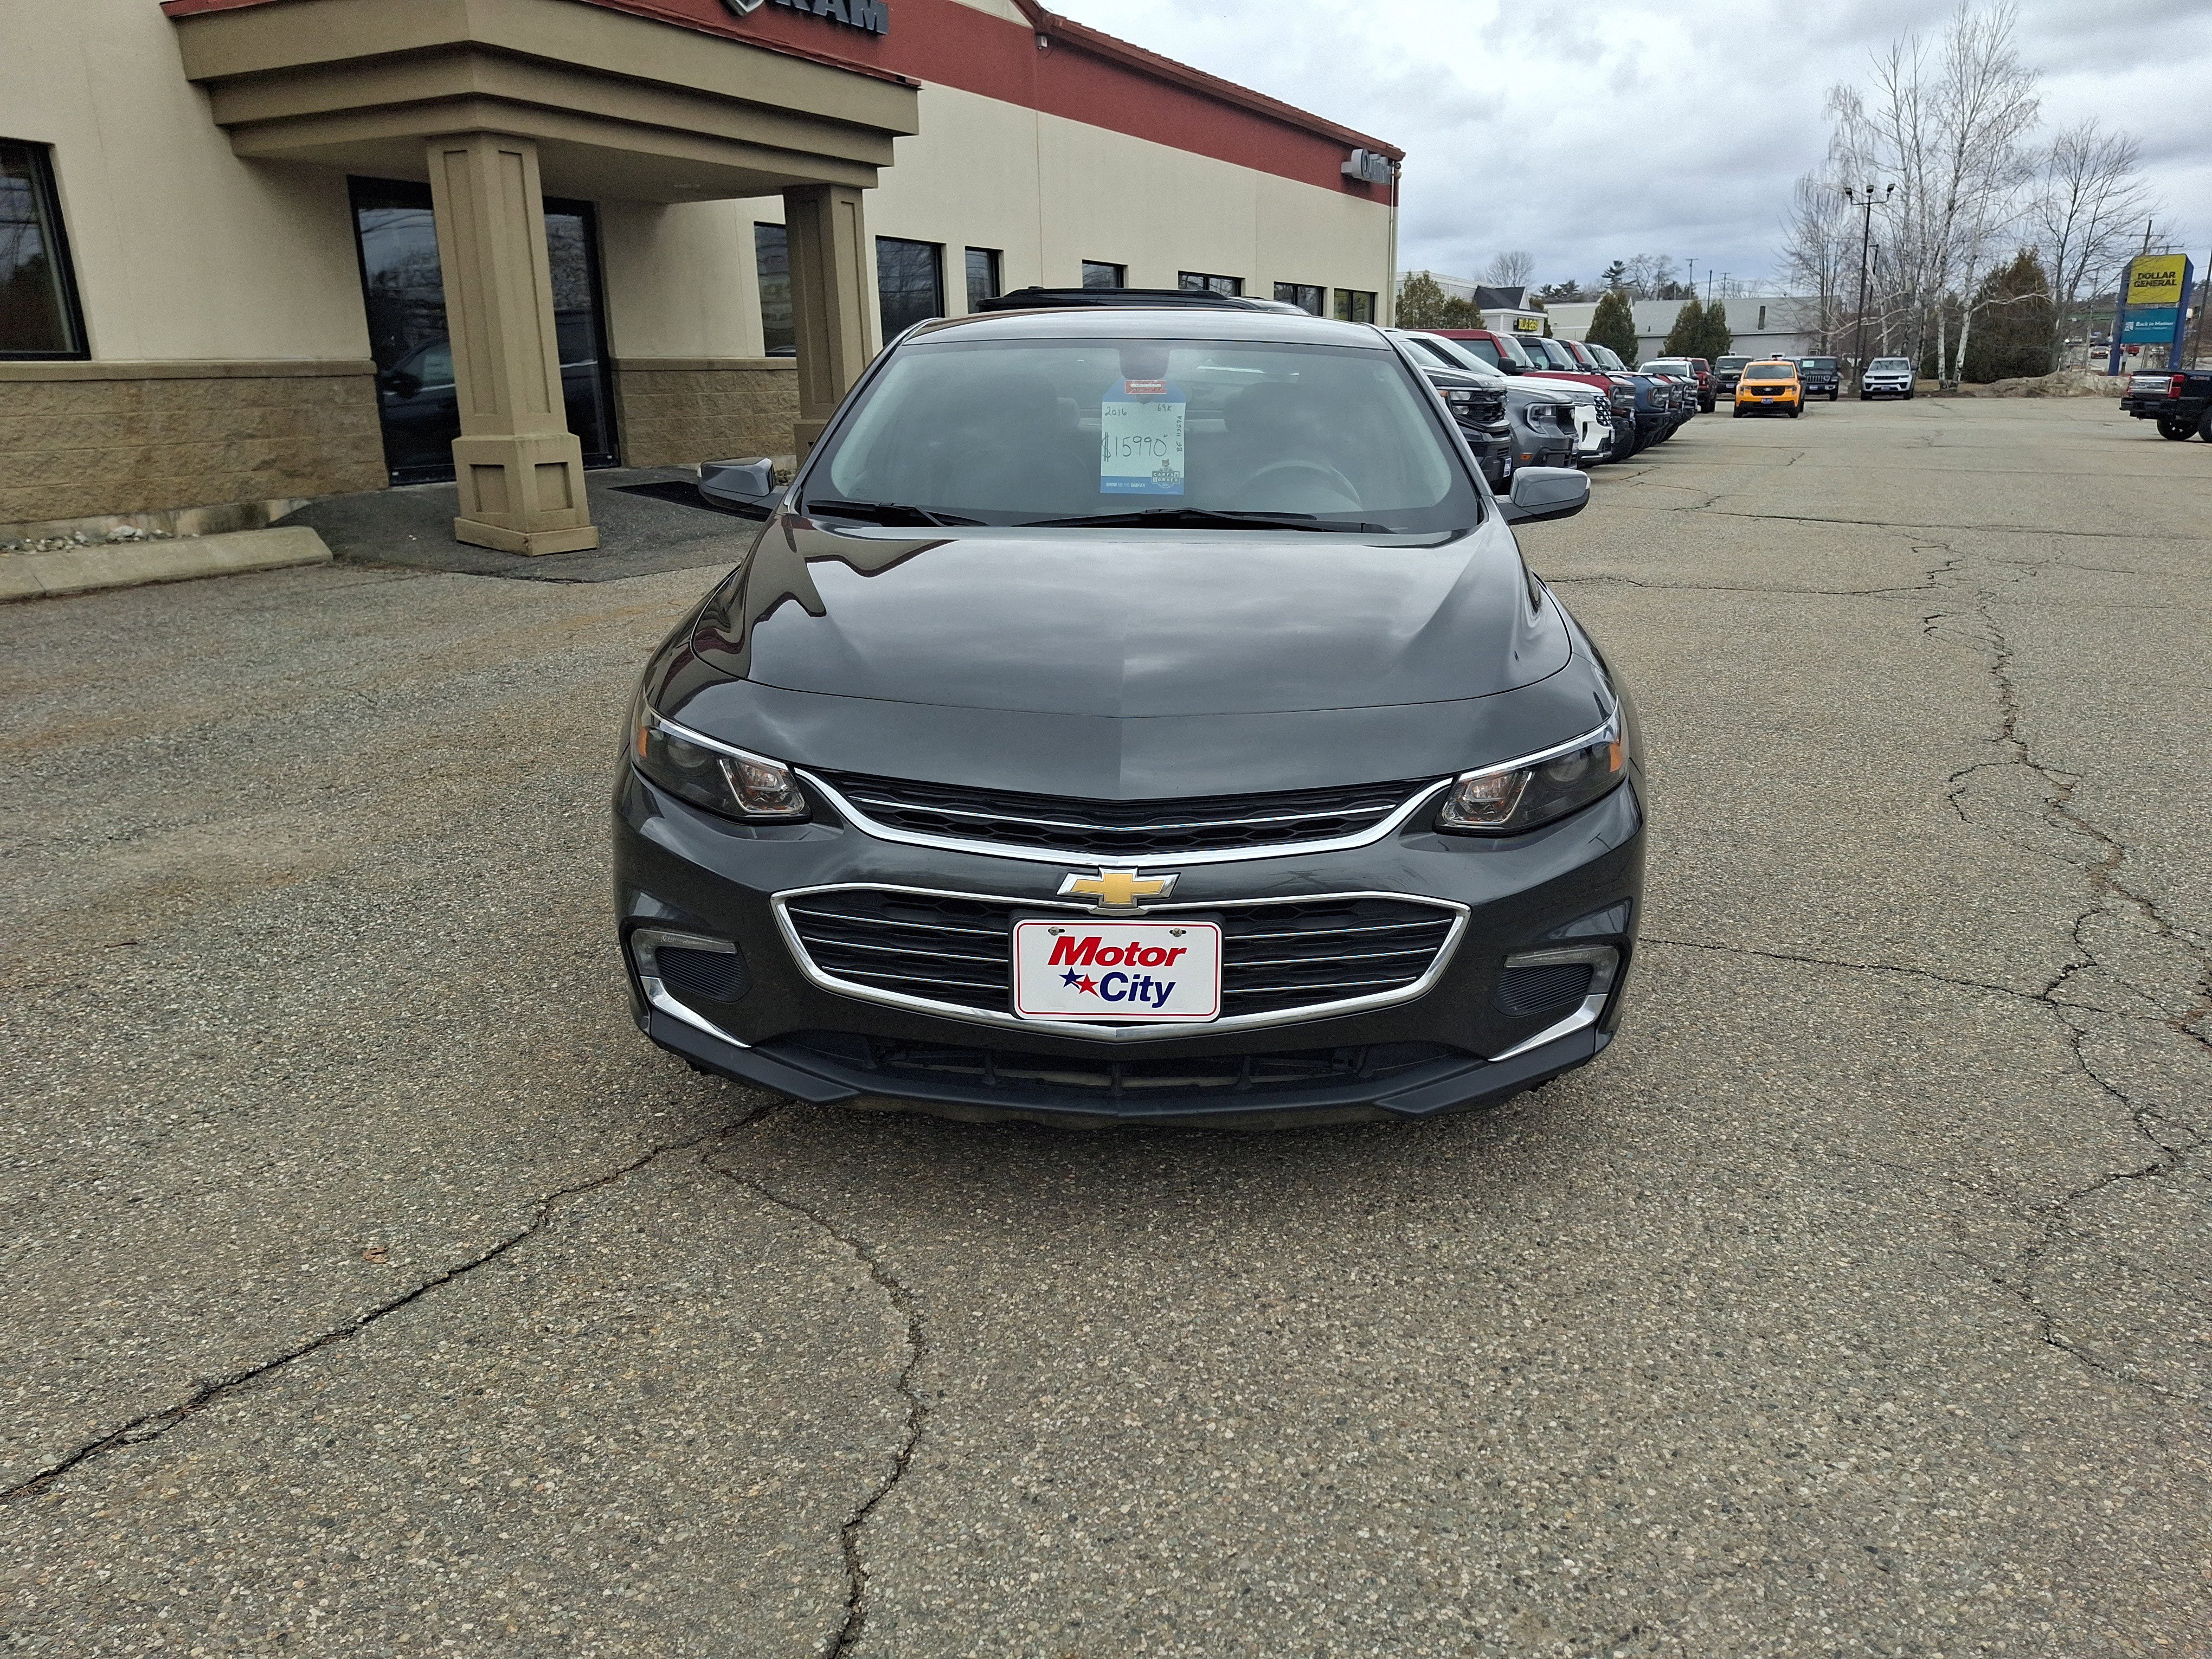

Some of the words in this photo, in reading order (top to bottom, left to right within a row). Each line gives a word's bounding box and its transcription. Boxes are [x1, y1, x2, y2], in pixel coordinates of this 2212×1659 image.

[776, 0, 889, 35] AM
[2134, 279, 2177, 287] GENERAL
[2137, 272, 2176, 280] DOLLAR
[1104, 407, 1127, 416] 2016
[1047, 936, 1187, 967] Motor
[1099, 972, 1176, 1008] City
